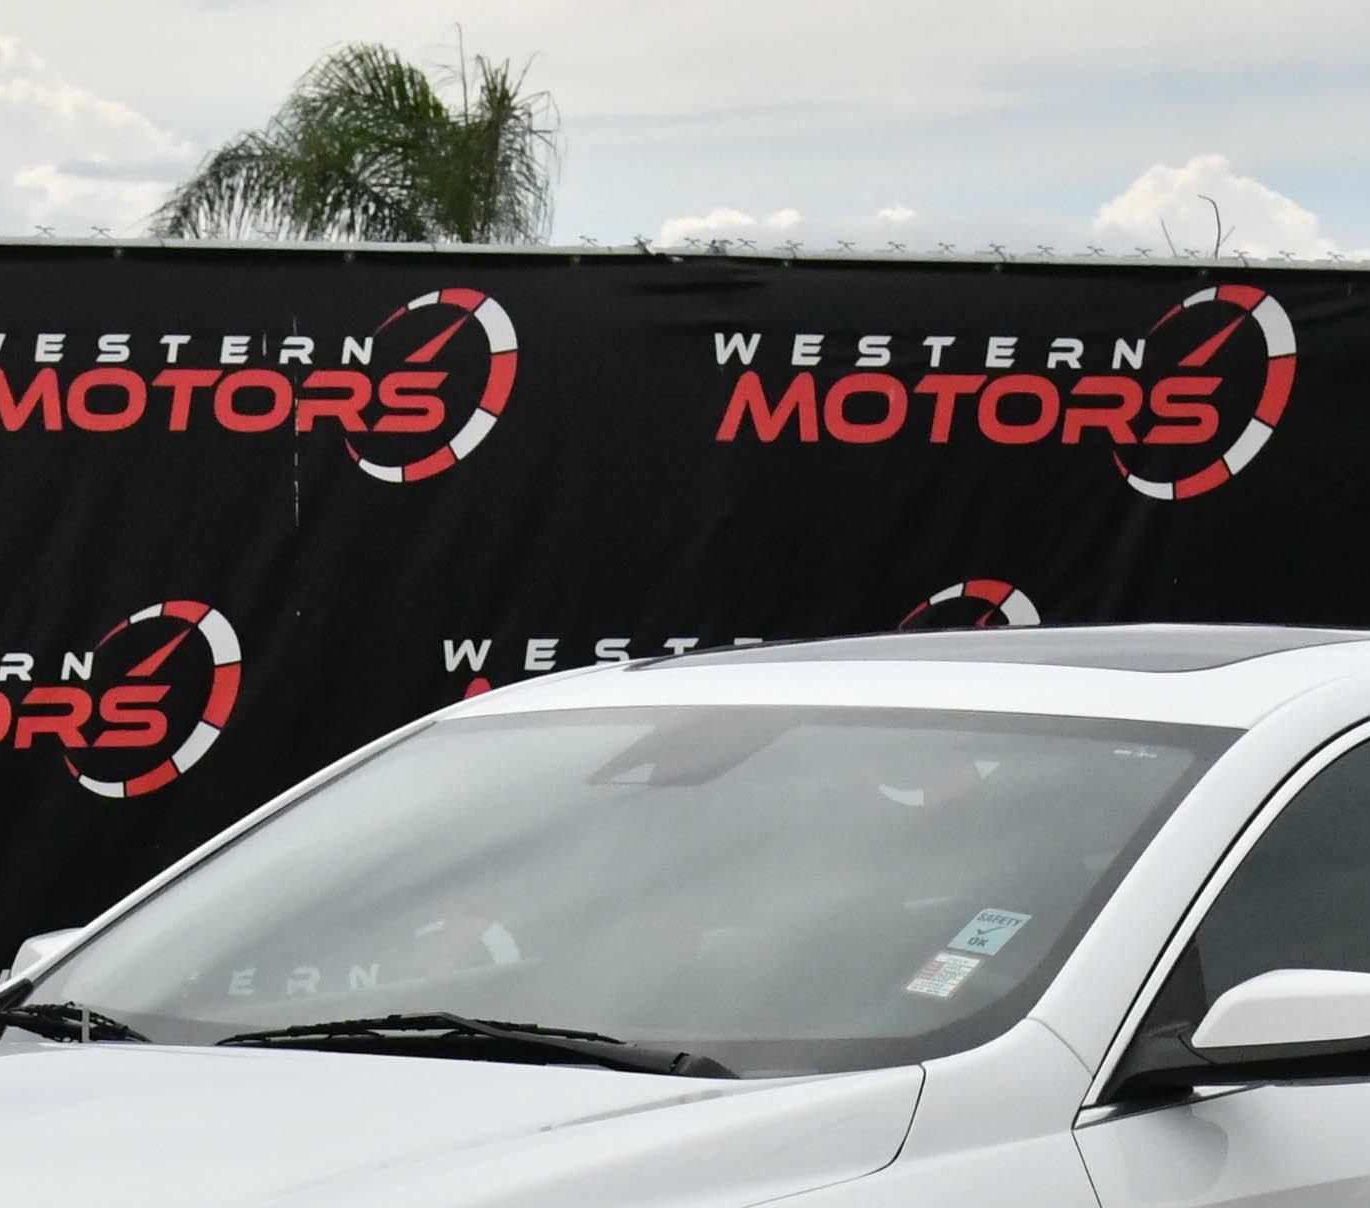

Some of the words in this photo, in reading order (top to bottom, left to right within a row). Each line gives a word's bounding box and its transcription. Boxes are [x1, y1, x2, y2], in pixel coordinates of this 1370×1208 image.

[714, 332, 1146, 370] WESTERN
[716, 370, 1222, 444] MOTORS
[967, 936, 989, 948] OK
